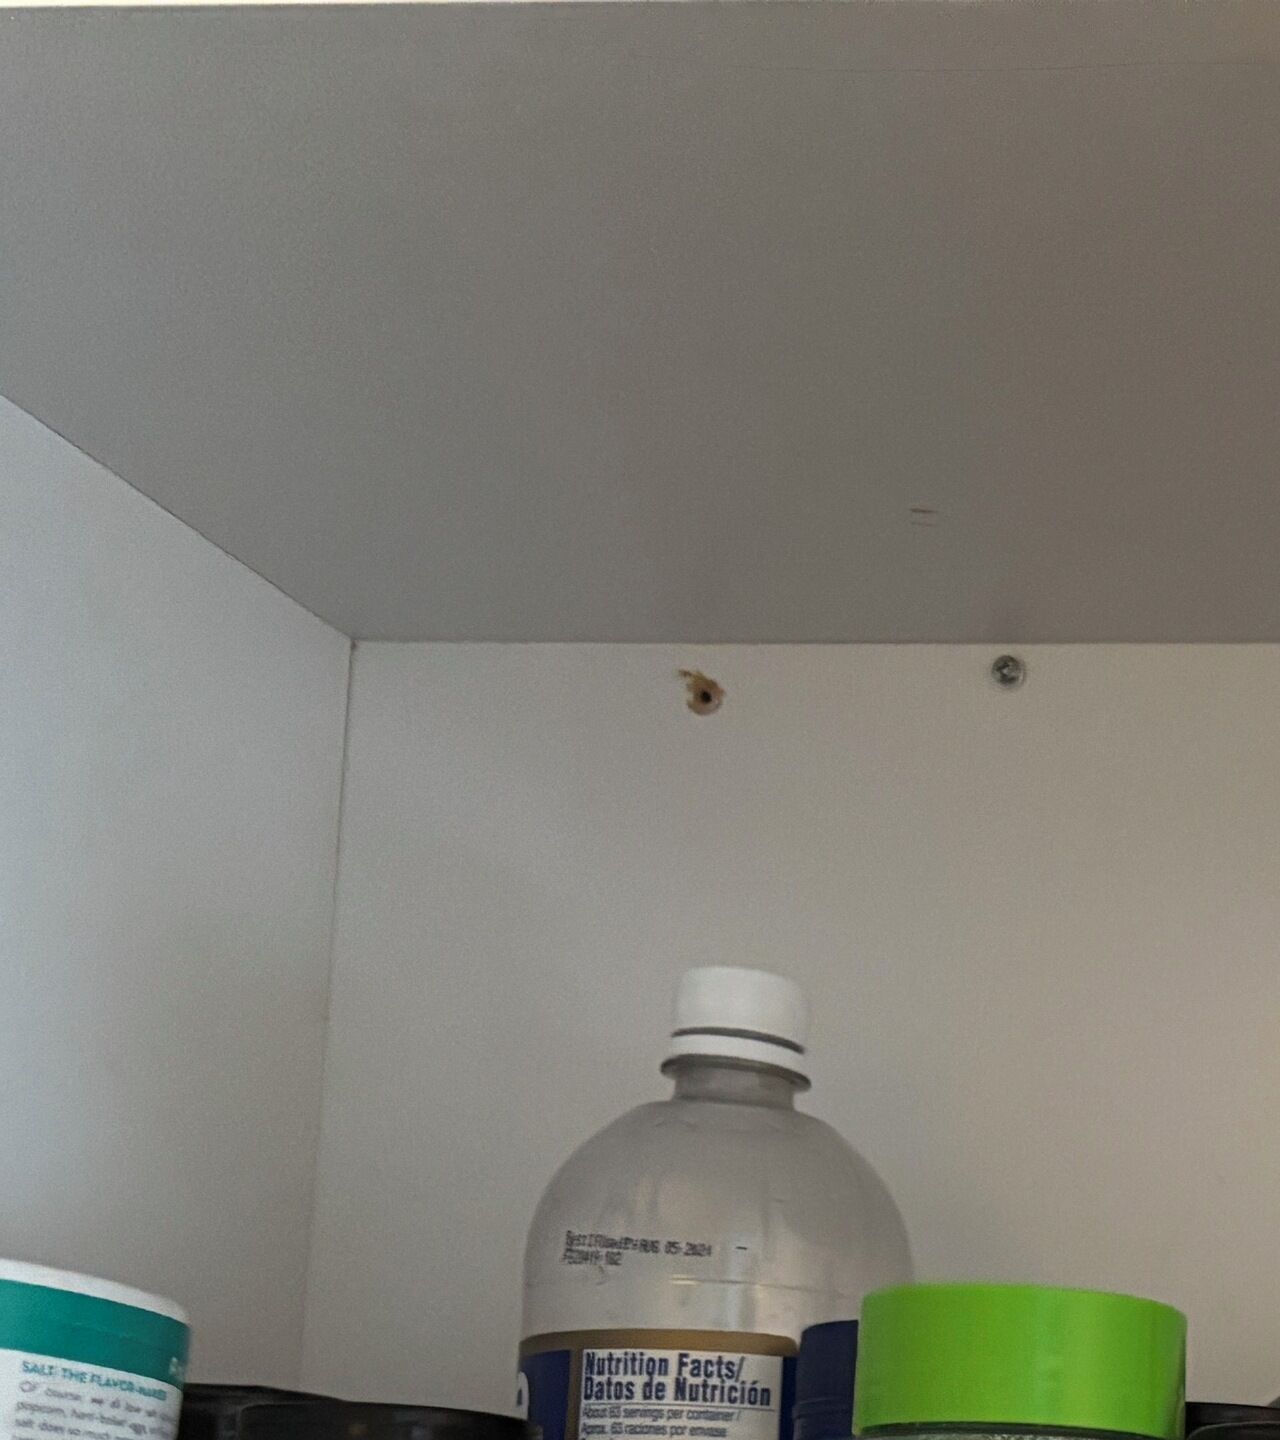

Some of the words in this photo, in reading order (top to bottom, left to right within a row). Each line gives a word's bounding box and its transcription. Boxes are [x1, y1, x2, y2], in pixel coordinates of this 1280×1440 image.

[585, 1352, 668, 1376] Nutrition
[62, 1368, 87, 1383] THE
[584, 1377, 635, 1400] Datos
[642, 1378, 665, 1400] de
[675, 1378, 770, 1406] Nutrición
[623, 1408, 664, 1421] servings
[667, 1409, 684, 1421] per
[670, 1426, 687, 1438] por
